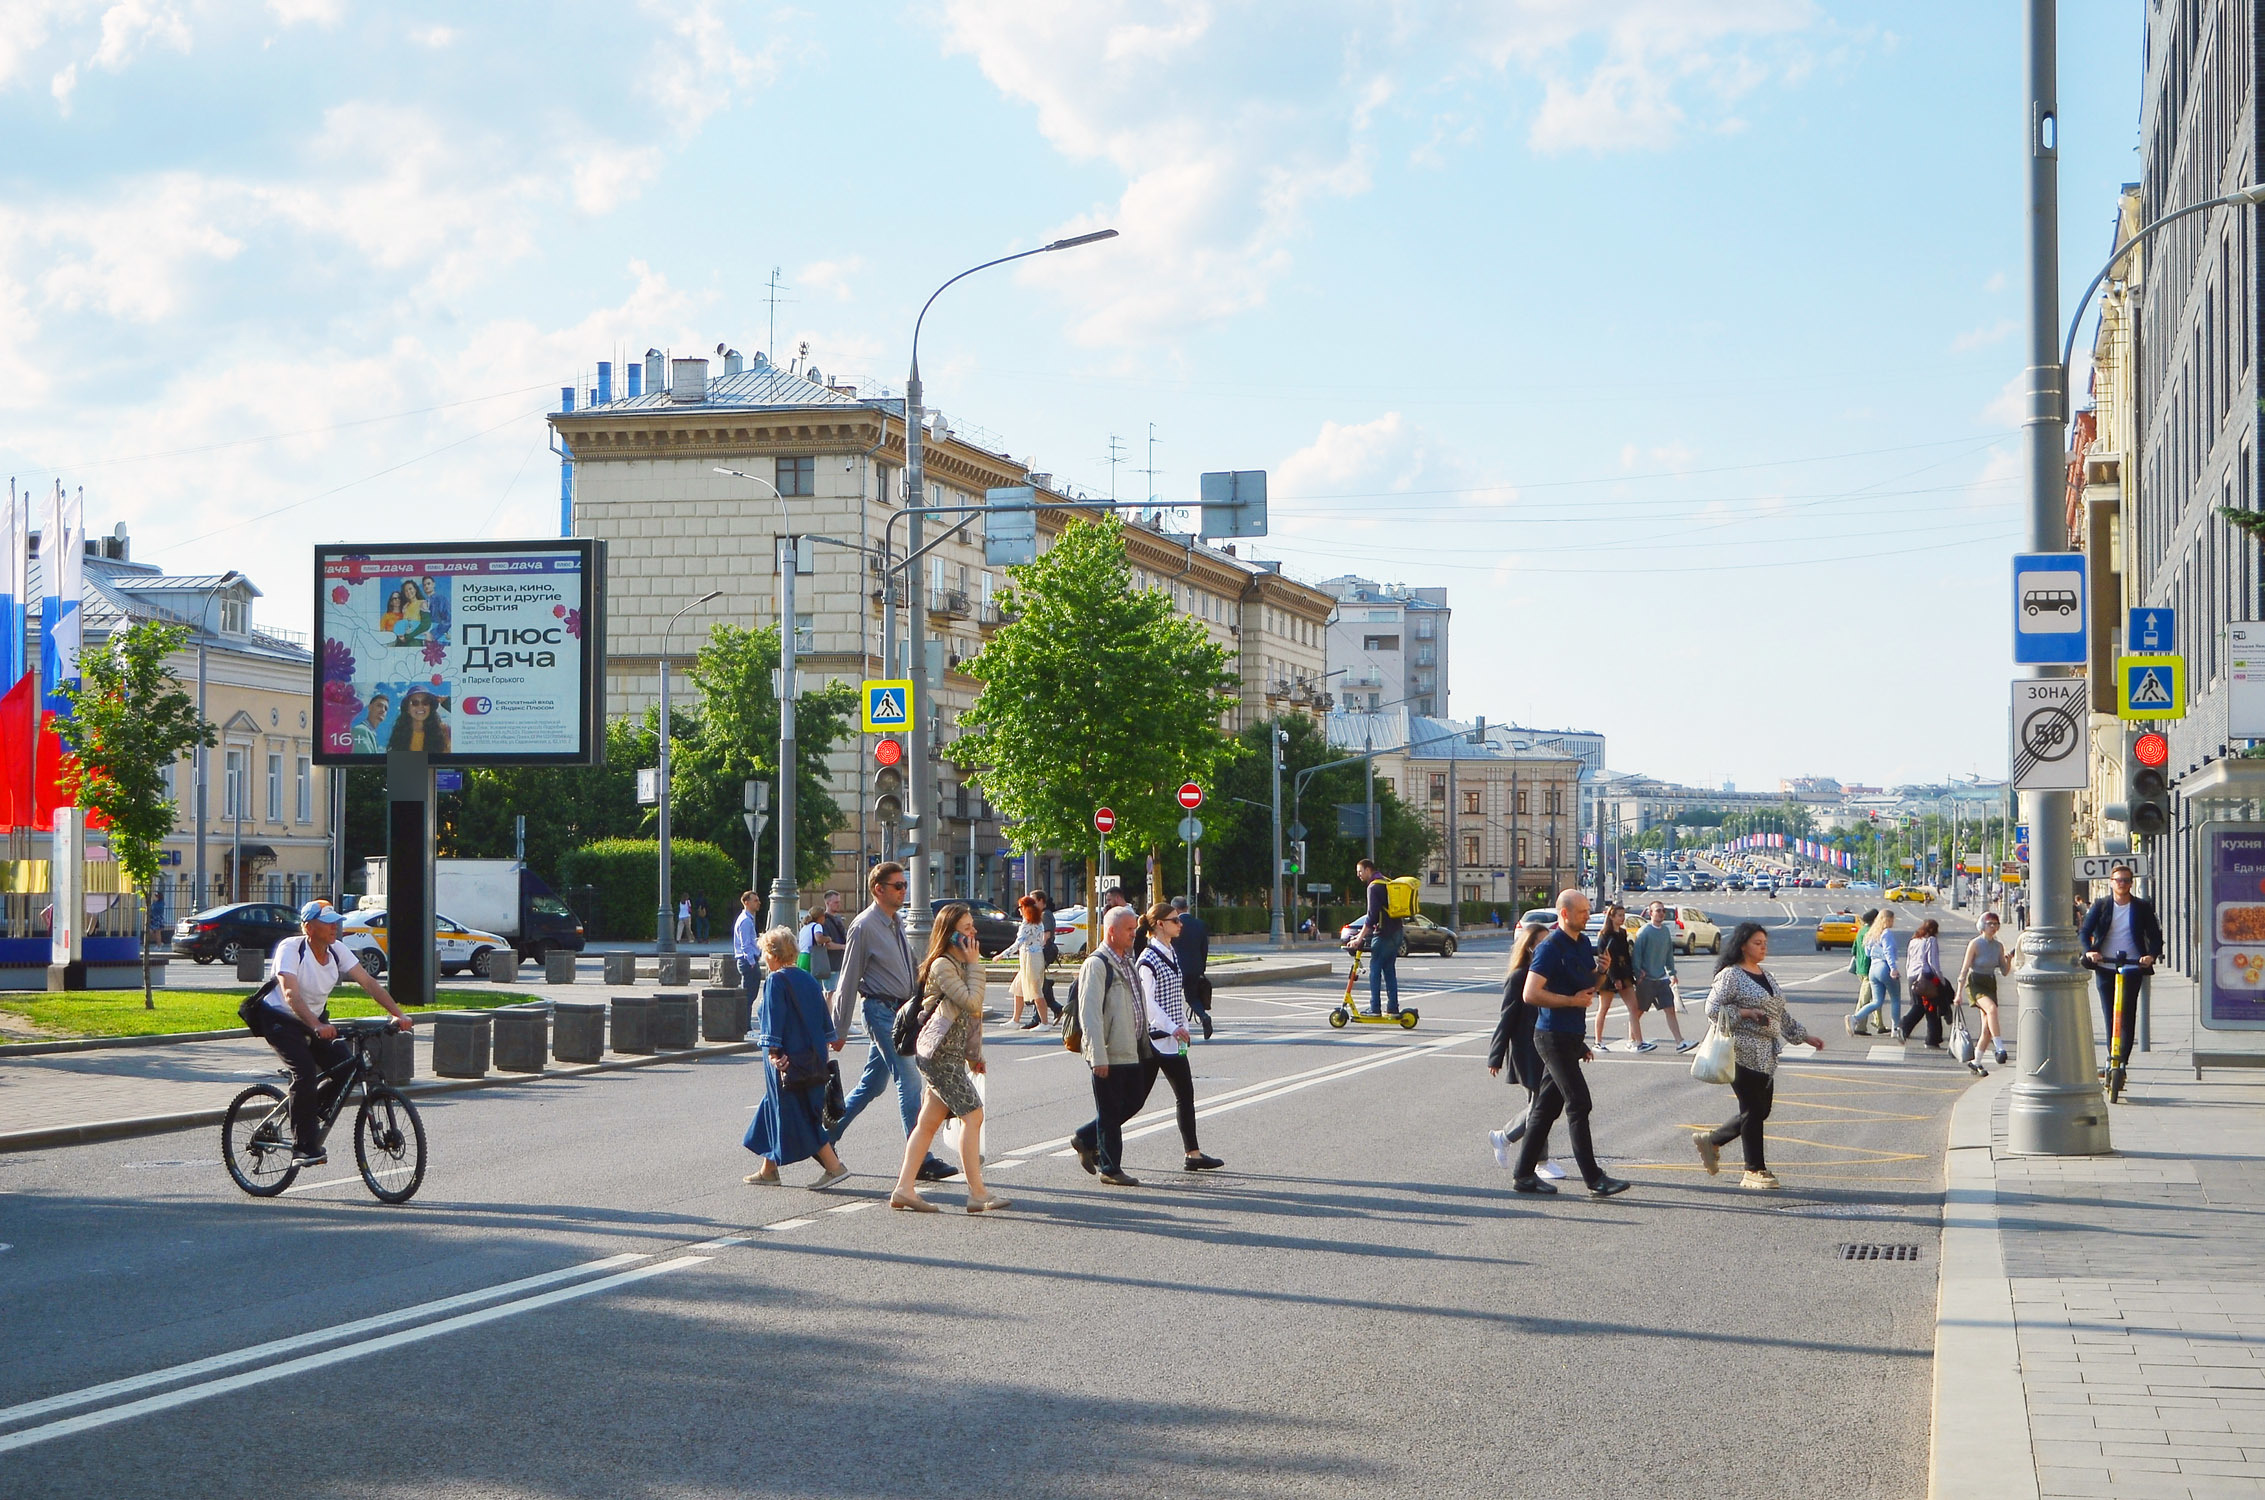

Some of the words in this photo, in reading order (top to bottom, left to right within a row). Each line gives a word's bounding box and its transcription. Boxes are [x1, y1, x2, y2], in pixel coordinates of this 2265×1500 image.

[325, 565, 350, 573] ача
[381, 564, 414, 572] дача
[445, 563, 478, 571] дача
[510, 562, 542, 570] дача
[462, 584, 517, 594] Музыка,
[462, 595, 501, 604] спорт
[514, 594, 562, 603] другие
[462, 603, 518, 612] события
[462, 624, 562, 645] Плюс
[462, 646, 556, 673] Дача
[468, 676, 490, 684] Парке
[492, 676, 524, 685] Горького
[2028, 686, 2070, 699] ЗОНА
[330, 732, 364, 746] 16+
[2221, 840, 2262, 850] кухня
[2234, 863, 2254, 874] Еда
